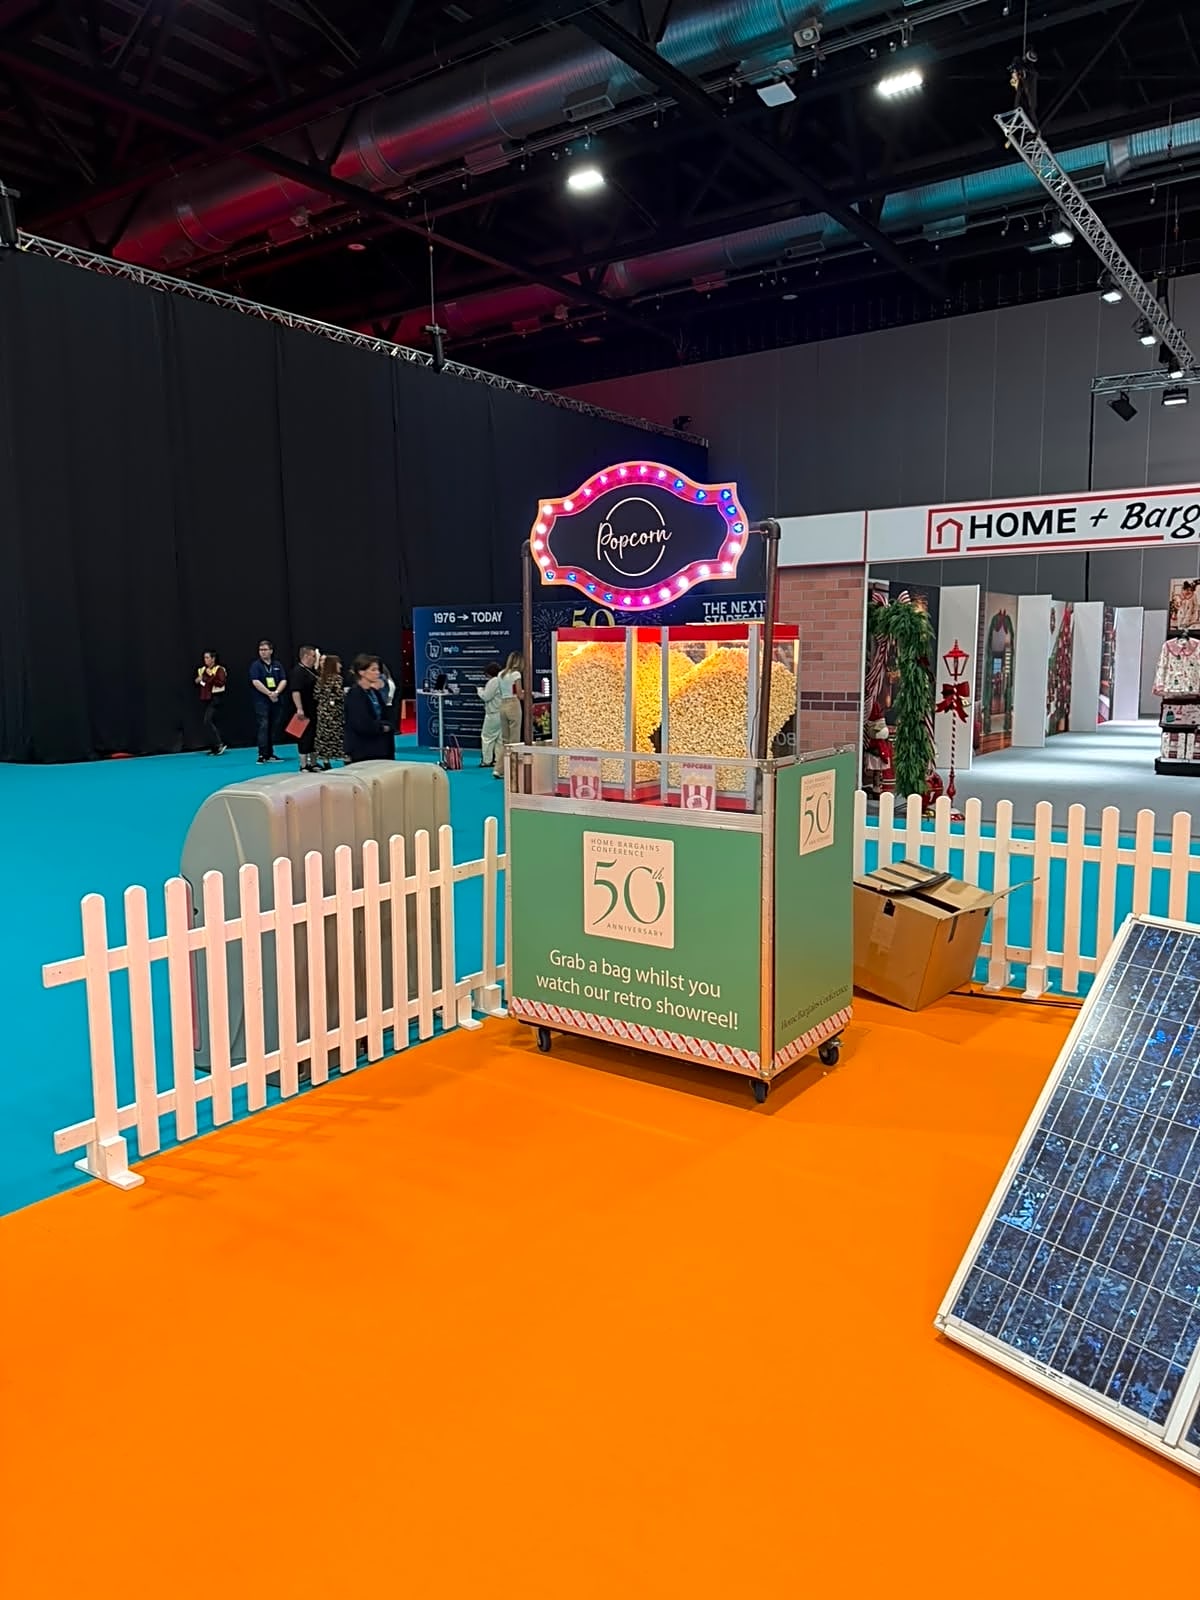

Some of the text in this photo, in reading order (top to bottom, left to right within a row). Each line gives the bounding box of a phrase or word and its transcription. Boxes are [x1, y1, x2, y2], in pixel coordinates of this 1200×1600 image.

[970, 508, 1077, 540] HOME
[1120, 502, 1200, 540] Barg
[597, 522, 672, 560] Popcorn
[702, 600, 766, 615] THE NEXT
[433, 611, 503, 624] 1976 TODAY
[682, 762, 713, 770] POPCORN
[591, 838, 661, 852] HOME BARGAINS
[591, 845, 645, 857] CONFERENCE
[606, 924, 663, 937] ANNIVERSARY
[549, 949, 721, 999] Grab a bag whilst you
[536, 975, 739, 1031] watch our retro showreel!
